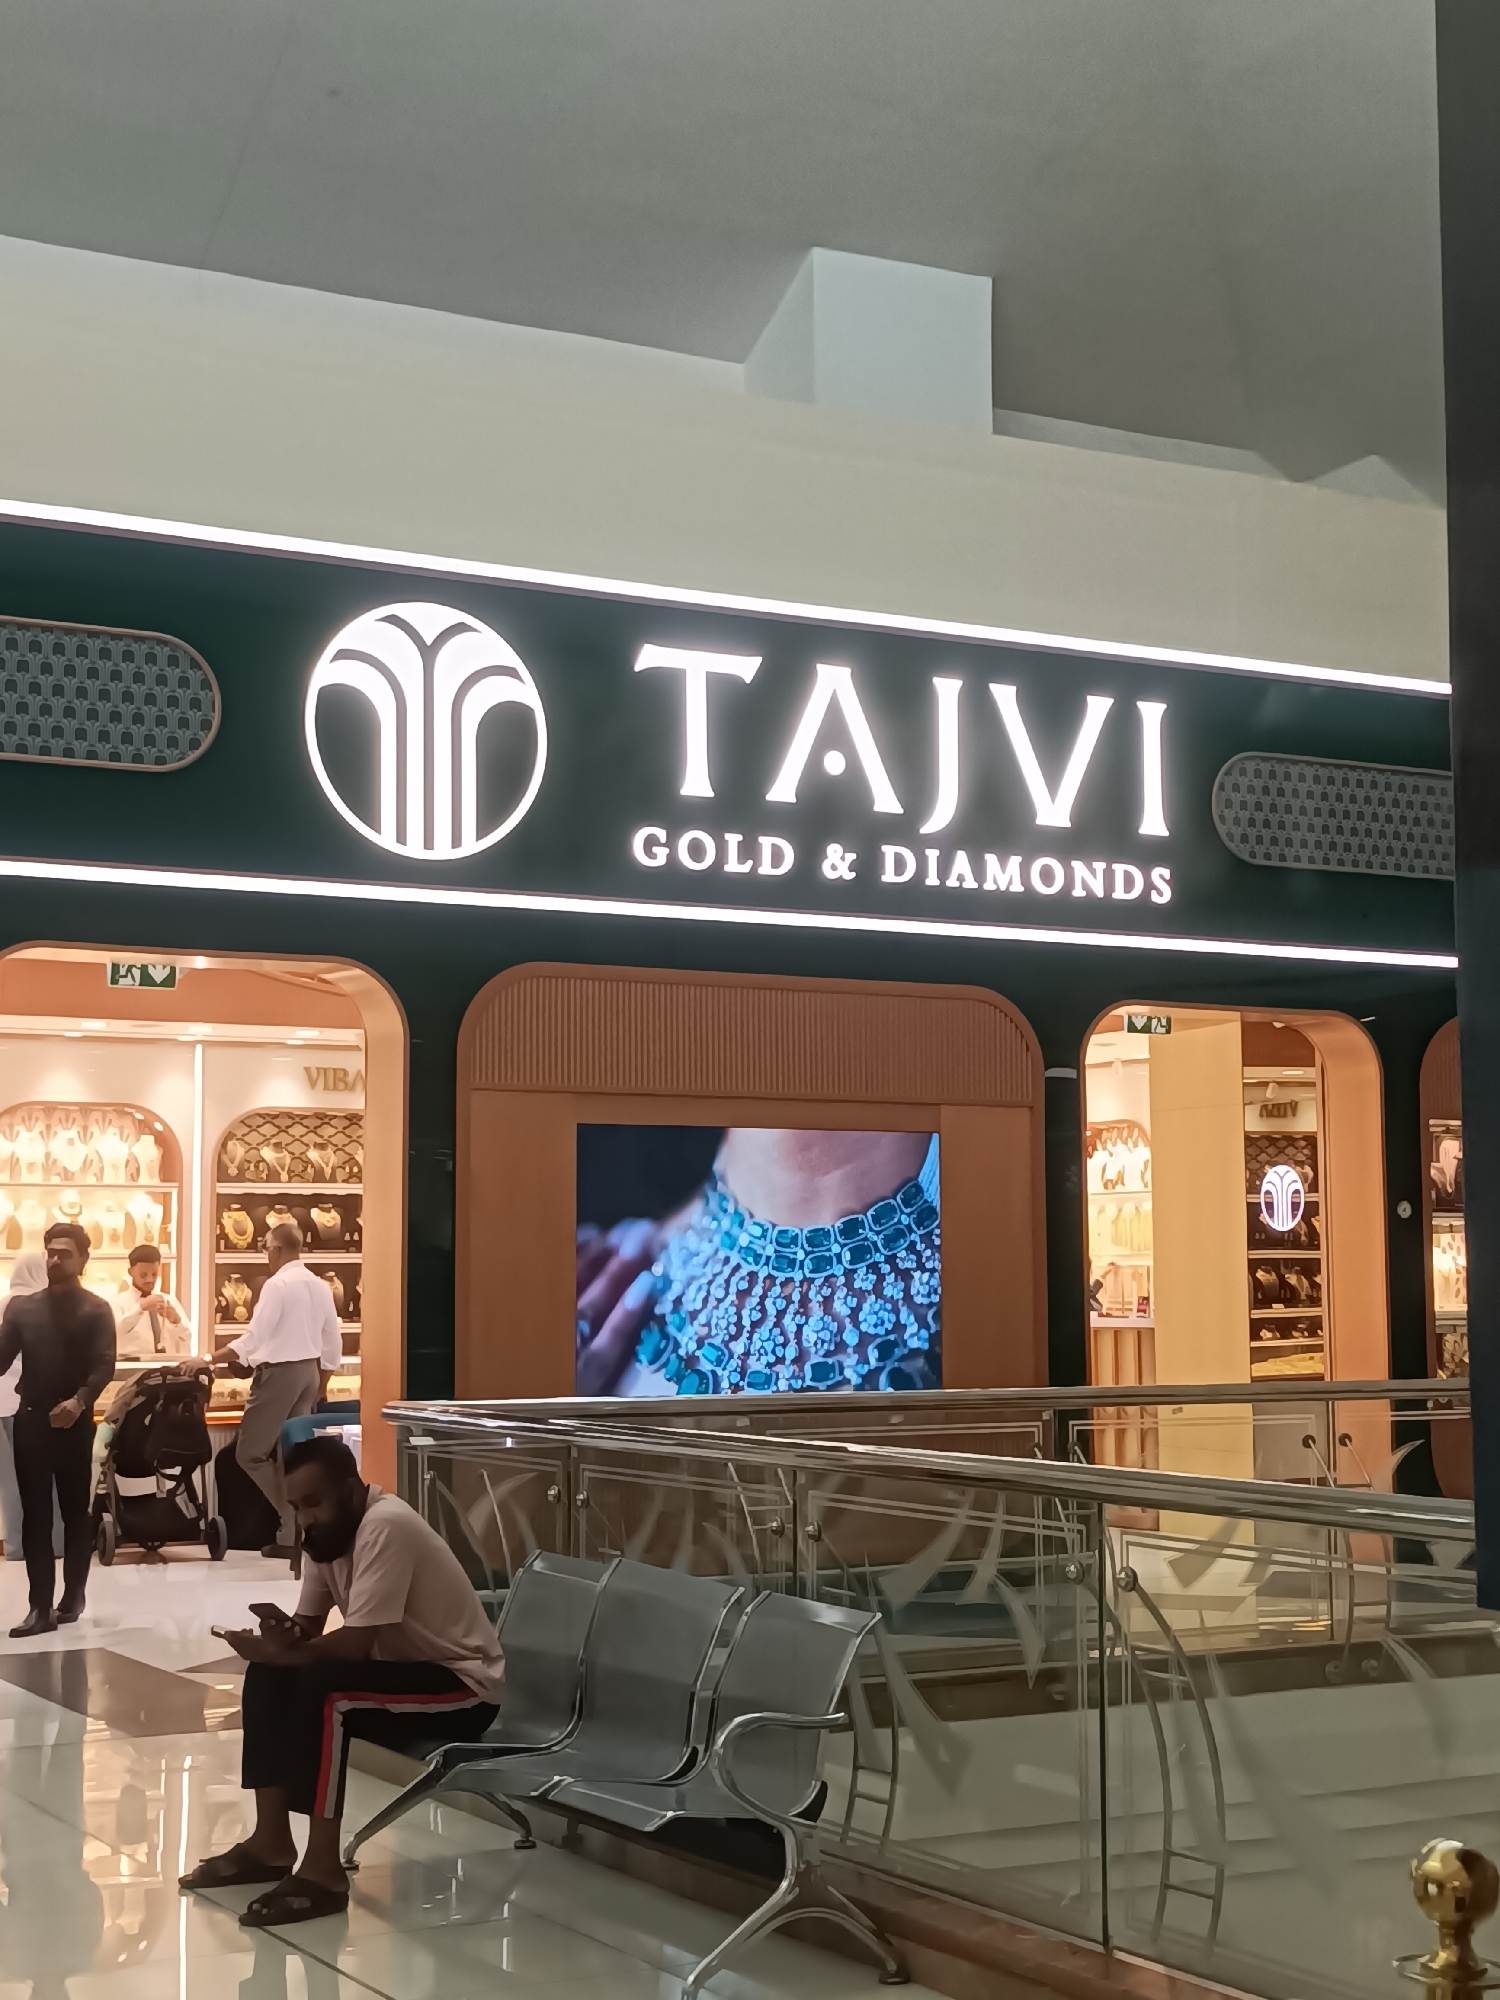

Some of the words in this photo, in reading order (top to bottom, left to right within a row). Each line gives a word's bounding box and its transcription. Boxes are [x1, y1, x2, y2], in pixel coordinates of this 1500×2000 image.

[633, 643, 1170, 837] TAJVI
[632, 826, 795, 876] GOLD
[821, 842, 857, 881] &
[880, 844, 1172, 905] DIAMONDS
